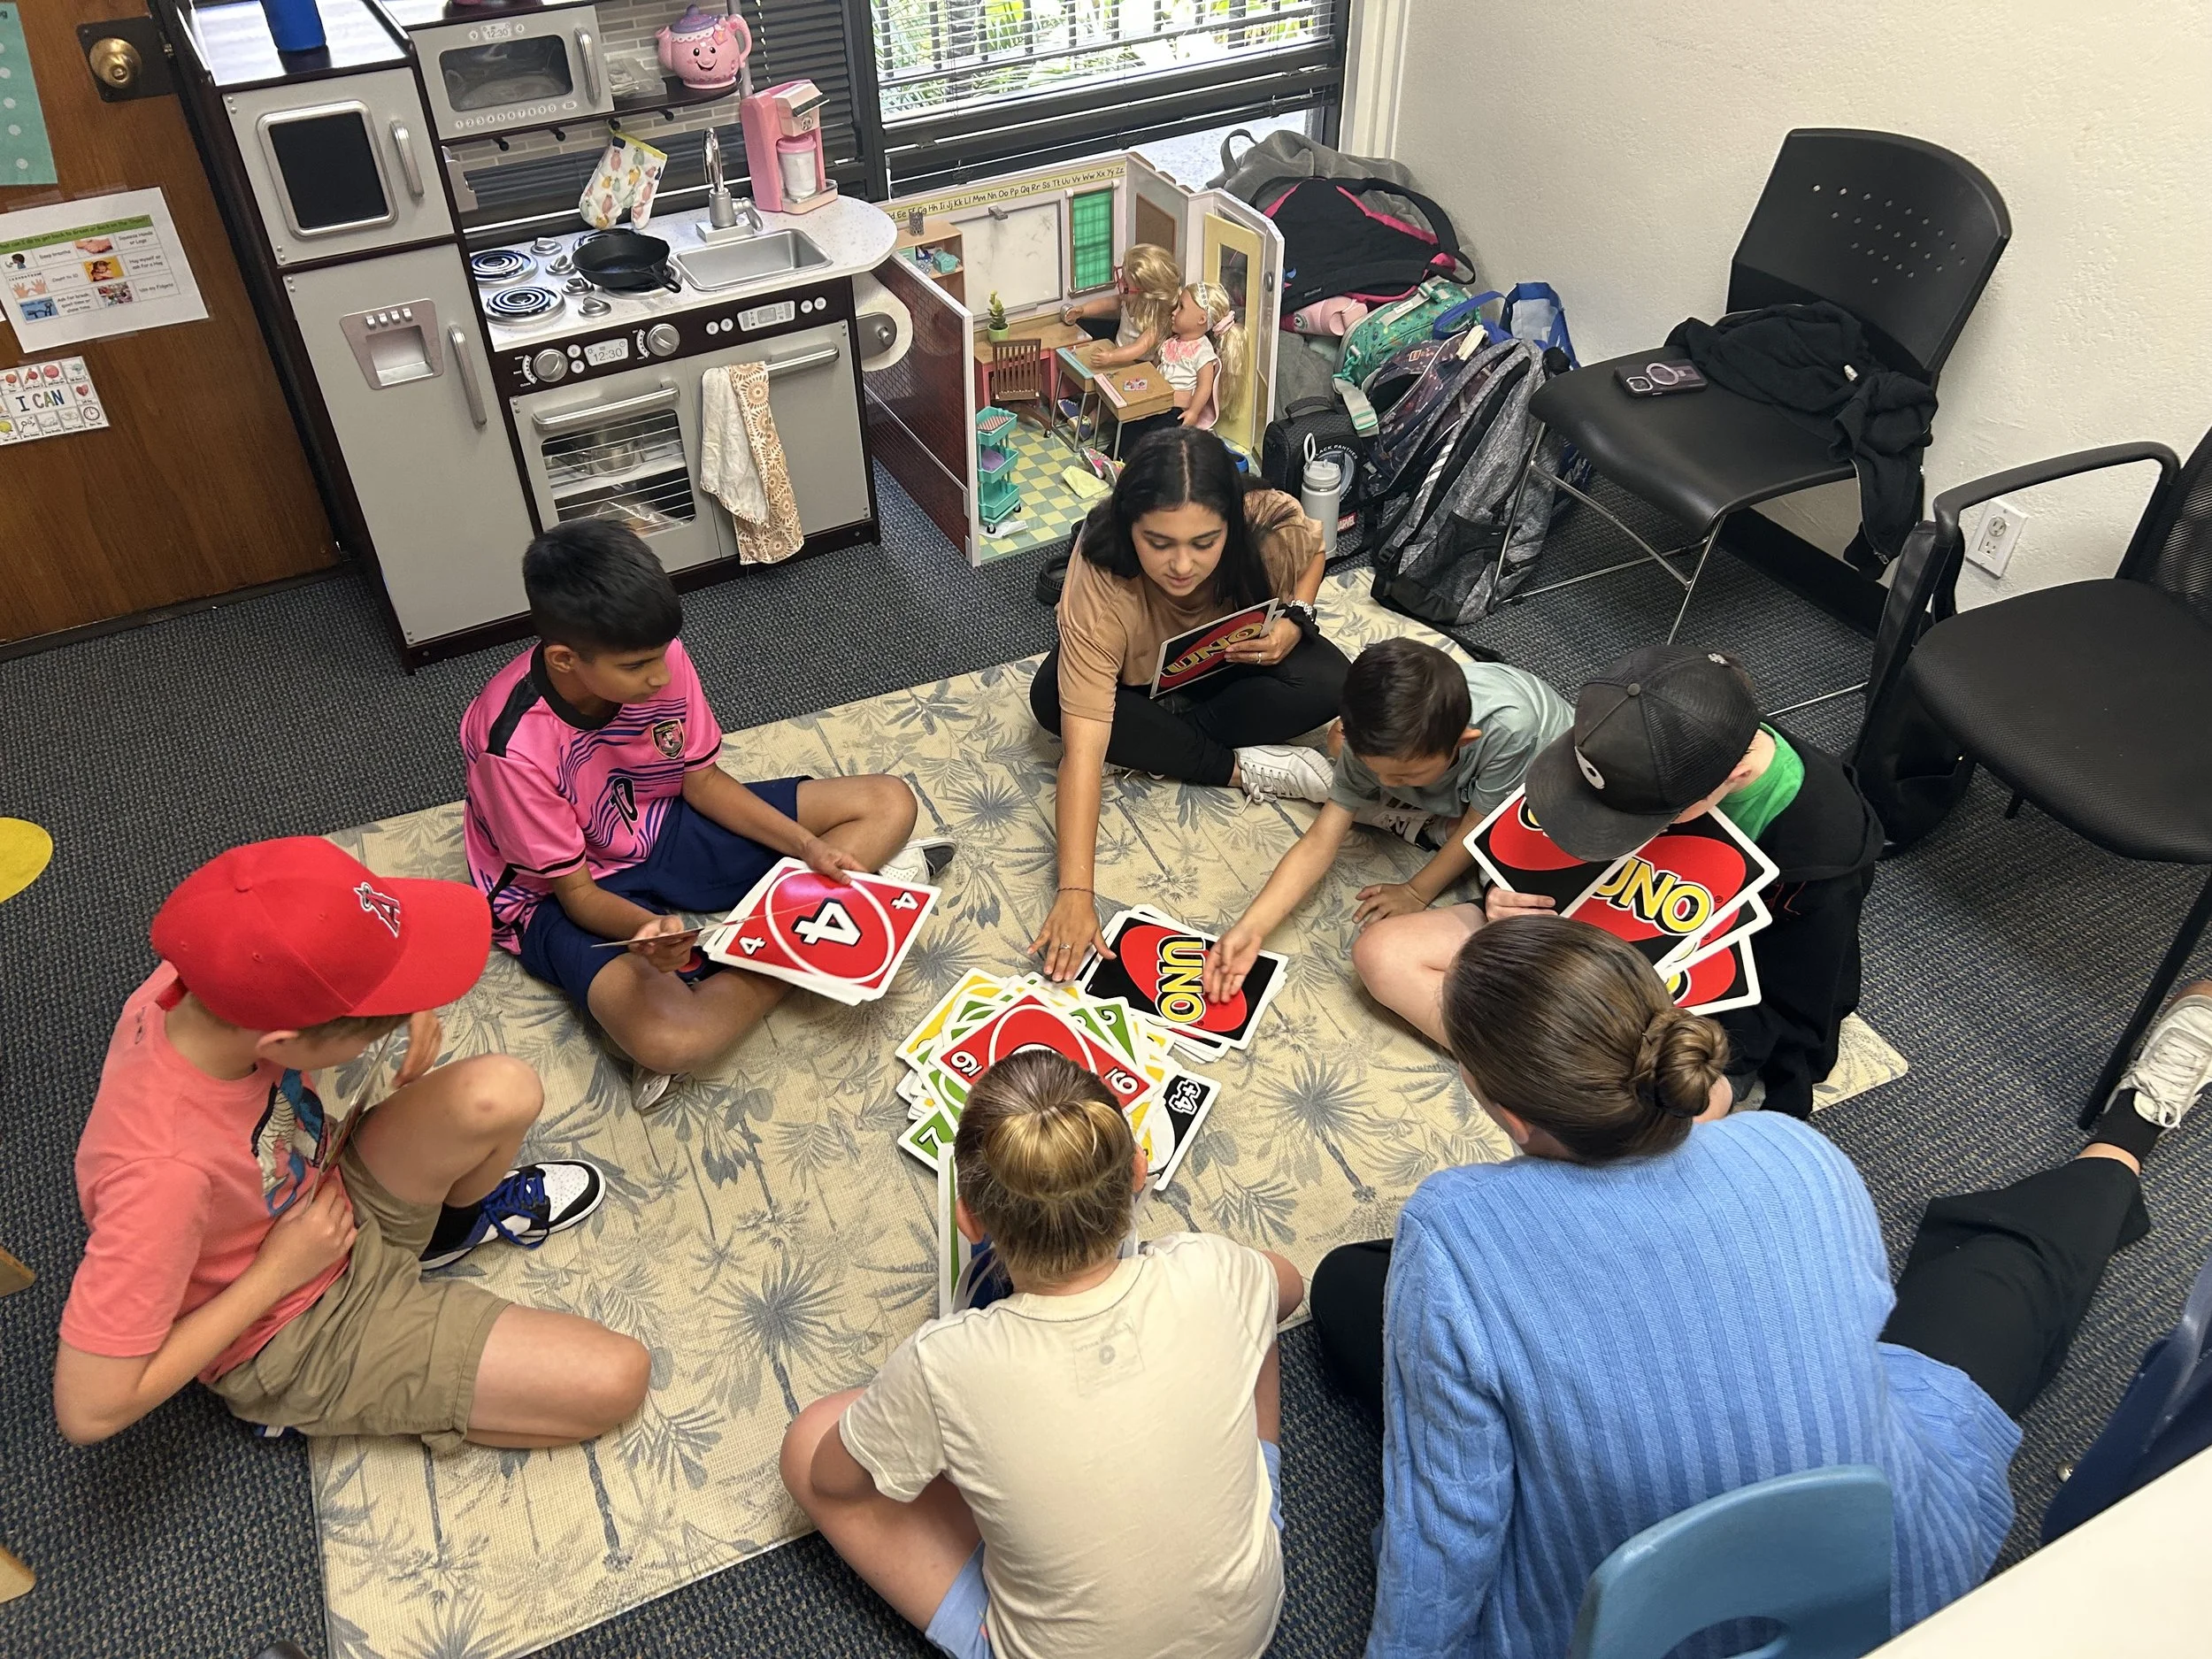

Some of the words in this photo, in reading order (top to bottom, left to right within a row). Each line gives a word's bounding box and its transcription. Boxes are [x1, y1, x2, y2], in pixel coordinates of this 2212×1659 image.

[487, 27, 509, 38] 12:30
[918, 206, 927, 215] Gg
[939, 202, 945, 211] Ii
[946, 202, 953, 211] Jj
[1010, 188, 1019, 196] Pp
[1020, 185, 1030, 194] Qq
[1031, 183, 1041, 192] Rr
[1042, 180, 1051, 189] Ss
[1052, 179, 1060, 188] Tt
[1061, 177, 1071, 186] Uu
[1071, 175, 1080, 184] Vv
[1106, 168, 1114, 177] Yy
[593, 347, 623, 362] 12:30
[15, 396, 30, 412] I
[32, 389, 65, 409] CAN
[1333, 444, 1358, 460] PANTHER
[1161, 622, 1263, 678] UNO
[891, 891, 918, 911] 4
[792, 897, 862, 947] 4
[739, 936, 766, 956] 4
[1156, 934, 1206, 1025] UNO
[950, 1050, 983, 1078] 9
[1105, 1066, 1139, 1094] 9
[1169, 1079, 1202, 1115] +4
[918, 1125, 944, 1150] 7
